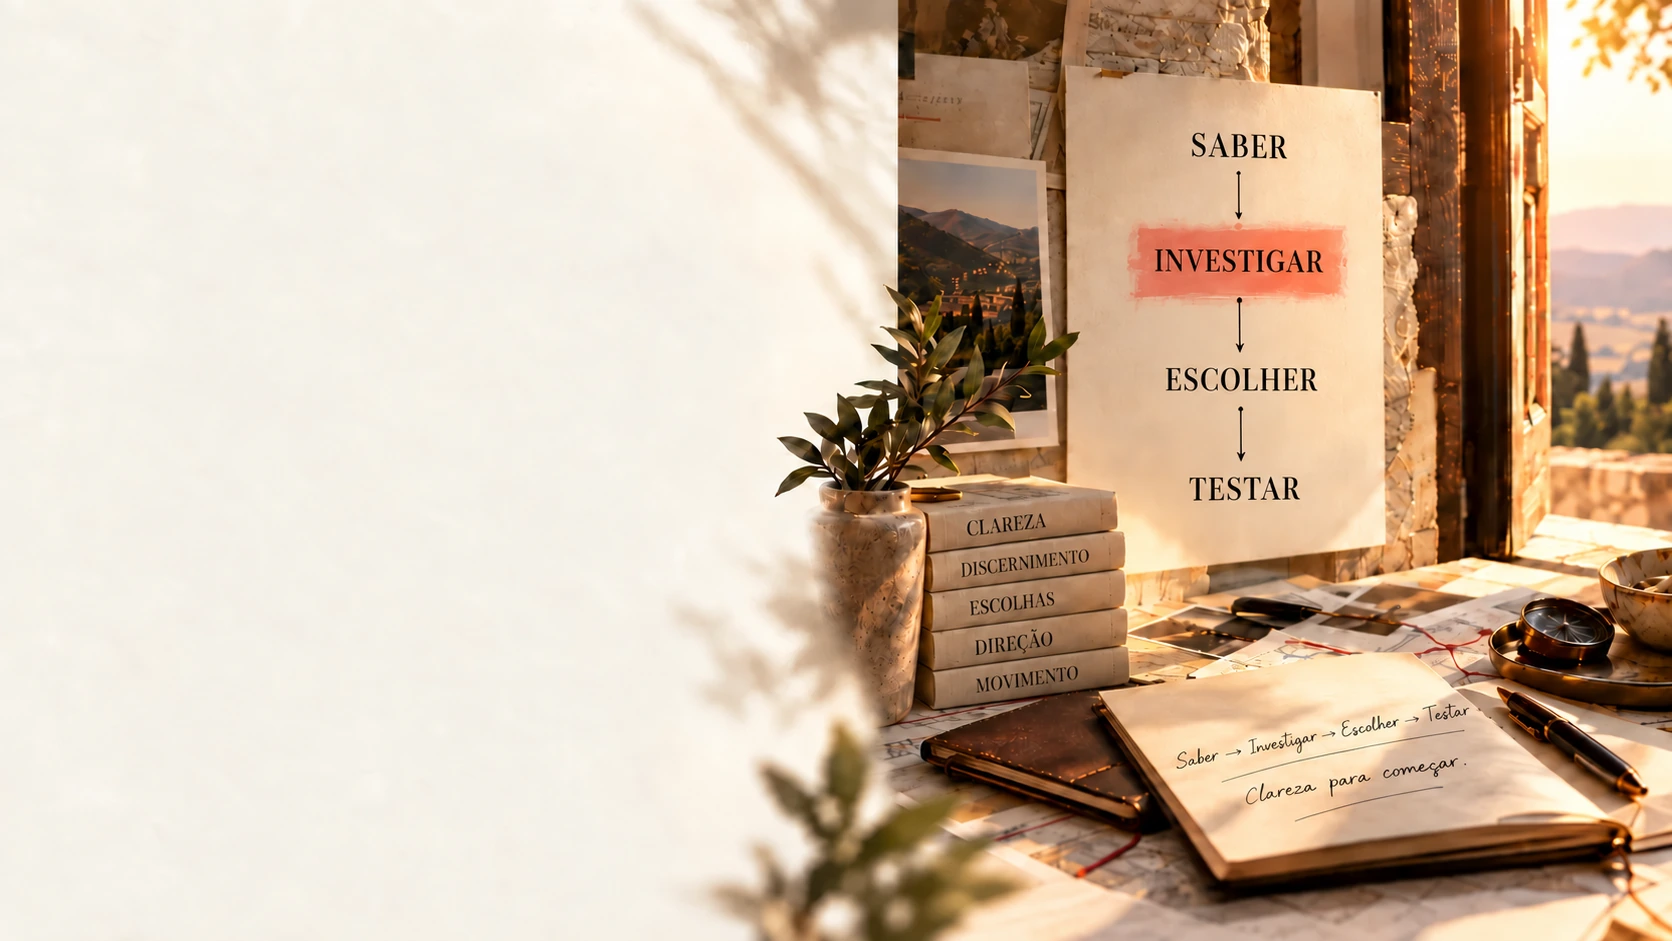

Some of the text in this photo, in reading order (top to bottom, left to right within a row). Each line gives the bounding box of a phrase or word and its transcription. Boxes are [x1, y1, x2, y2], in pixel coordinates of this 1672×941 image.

[1191, 132, 1288, 160] SABER
[1154, 248, 1324, 274] INVESTIGAR
[1165, 367, 1318, 392] ESCOLHER
[1188, 476, 1301, 502] TESTAR
[966, 513, 1047, 537] CLAREZA
[960, 548, 1090, 578] DISCERNIMENTO
[969, 591, 1056, 617] ESCOLHAS
[974, 628, 1054, 656] DIREÇÃO
[975, 665, 1079, 694] MOVIMENTO
[1176, 703, 1470, 770] Saber Investigar Escolher Testar
[1245, 782, 1317, 805] Clareza
[1329, 774, 1372, 798] para
